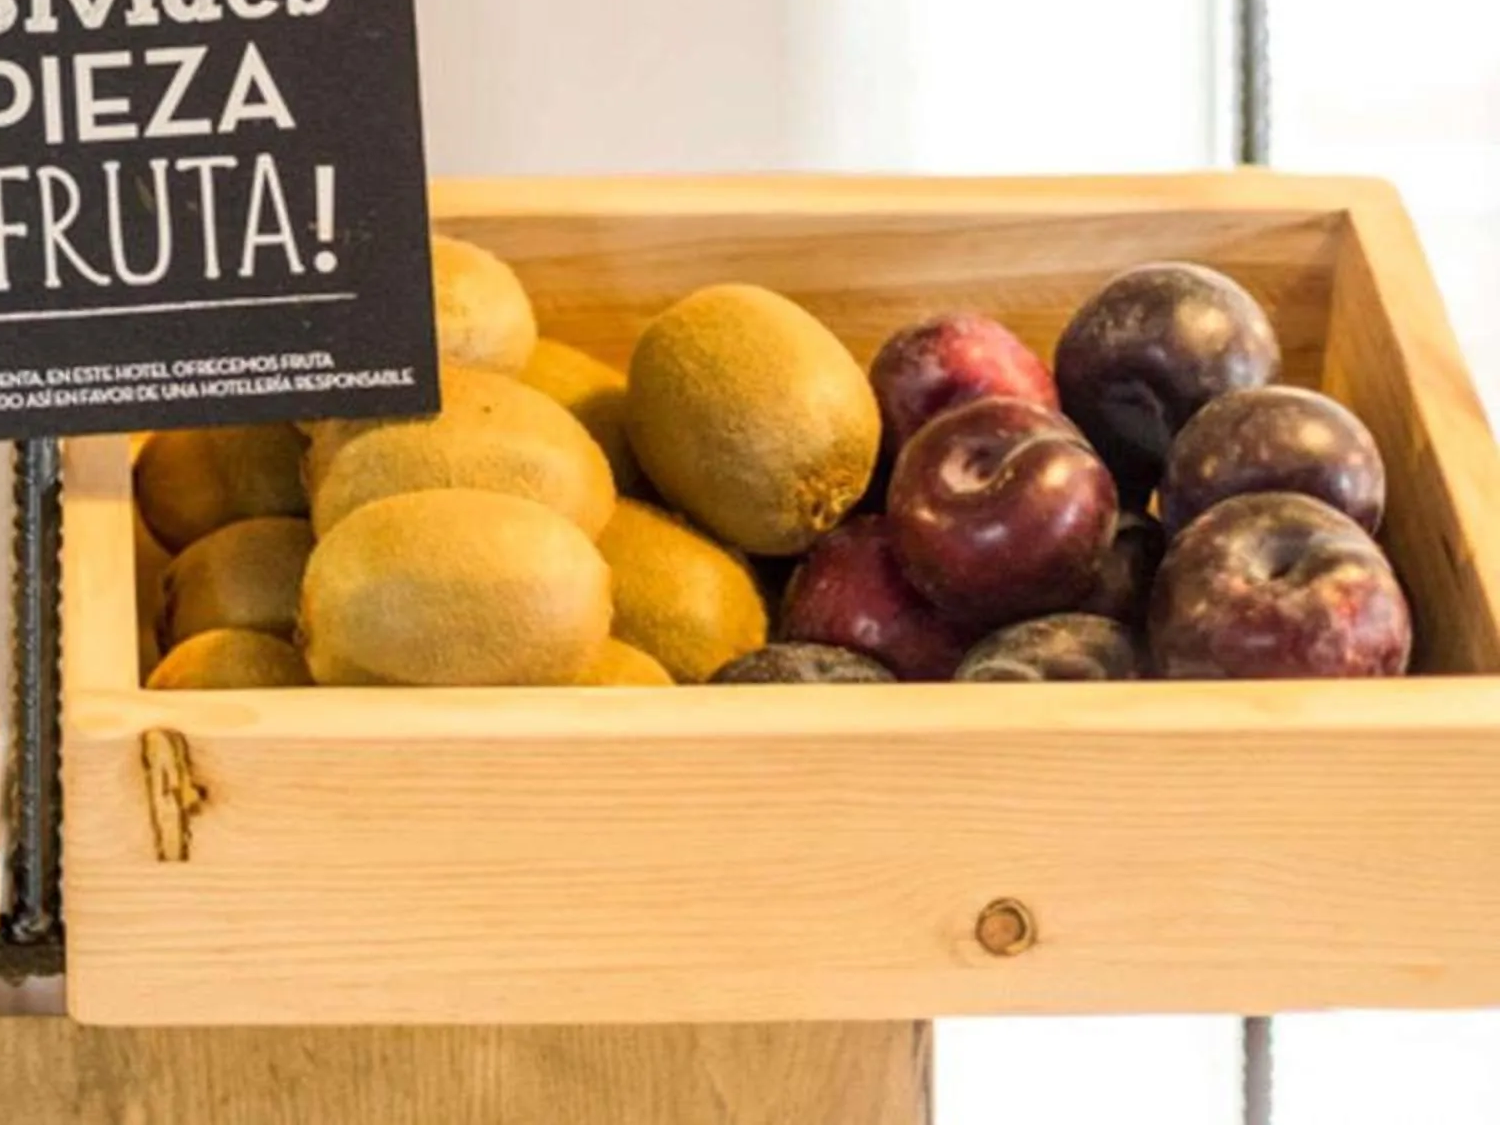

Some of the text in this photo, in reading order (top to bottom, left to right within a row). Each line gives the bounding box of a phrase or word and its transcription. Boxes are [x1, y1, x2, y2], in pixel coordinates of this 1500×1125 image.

[46, 367, 71, 386] EN
[73, 365, 113, 384] ESTE
[115, 362, 170, 381] HOTEL
[171, 355, 278, 376] OFRECEMOS
[279, 350, 335, 371] FRUTA
[54, 388, 77, 407] EN
[79, 385, 134, 405] FAVOR
[136, 383, 160, 402] DE
[161, 381, 199, 401] UNA
[200, 373, 292, 398] HOTELERÍA
[293, 366, 416, 392] RESPONSABLE
